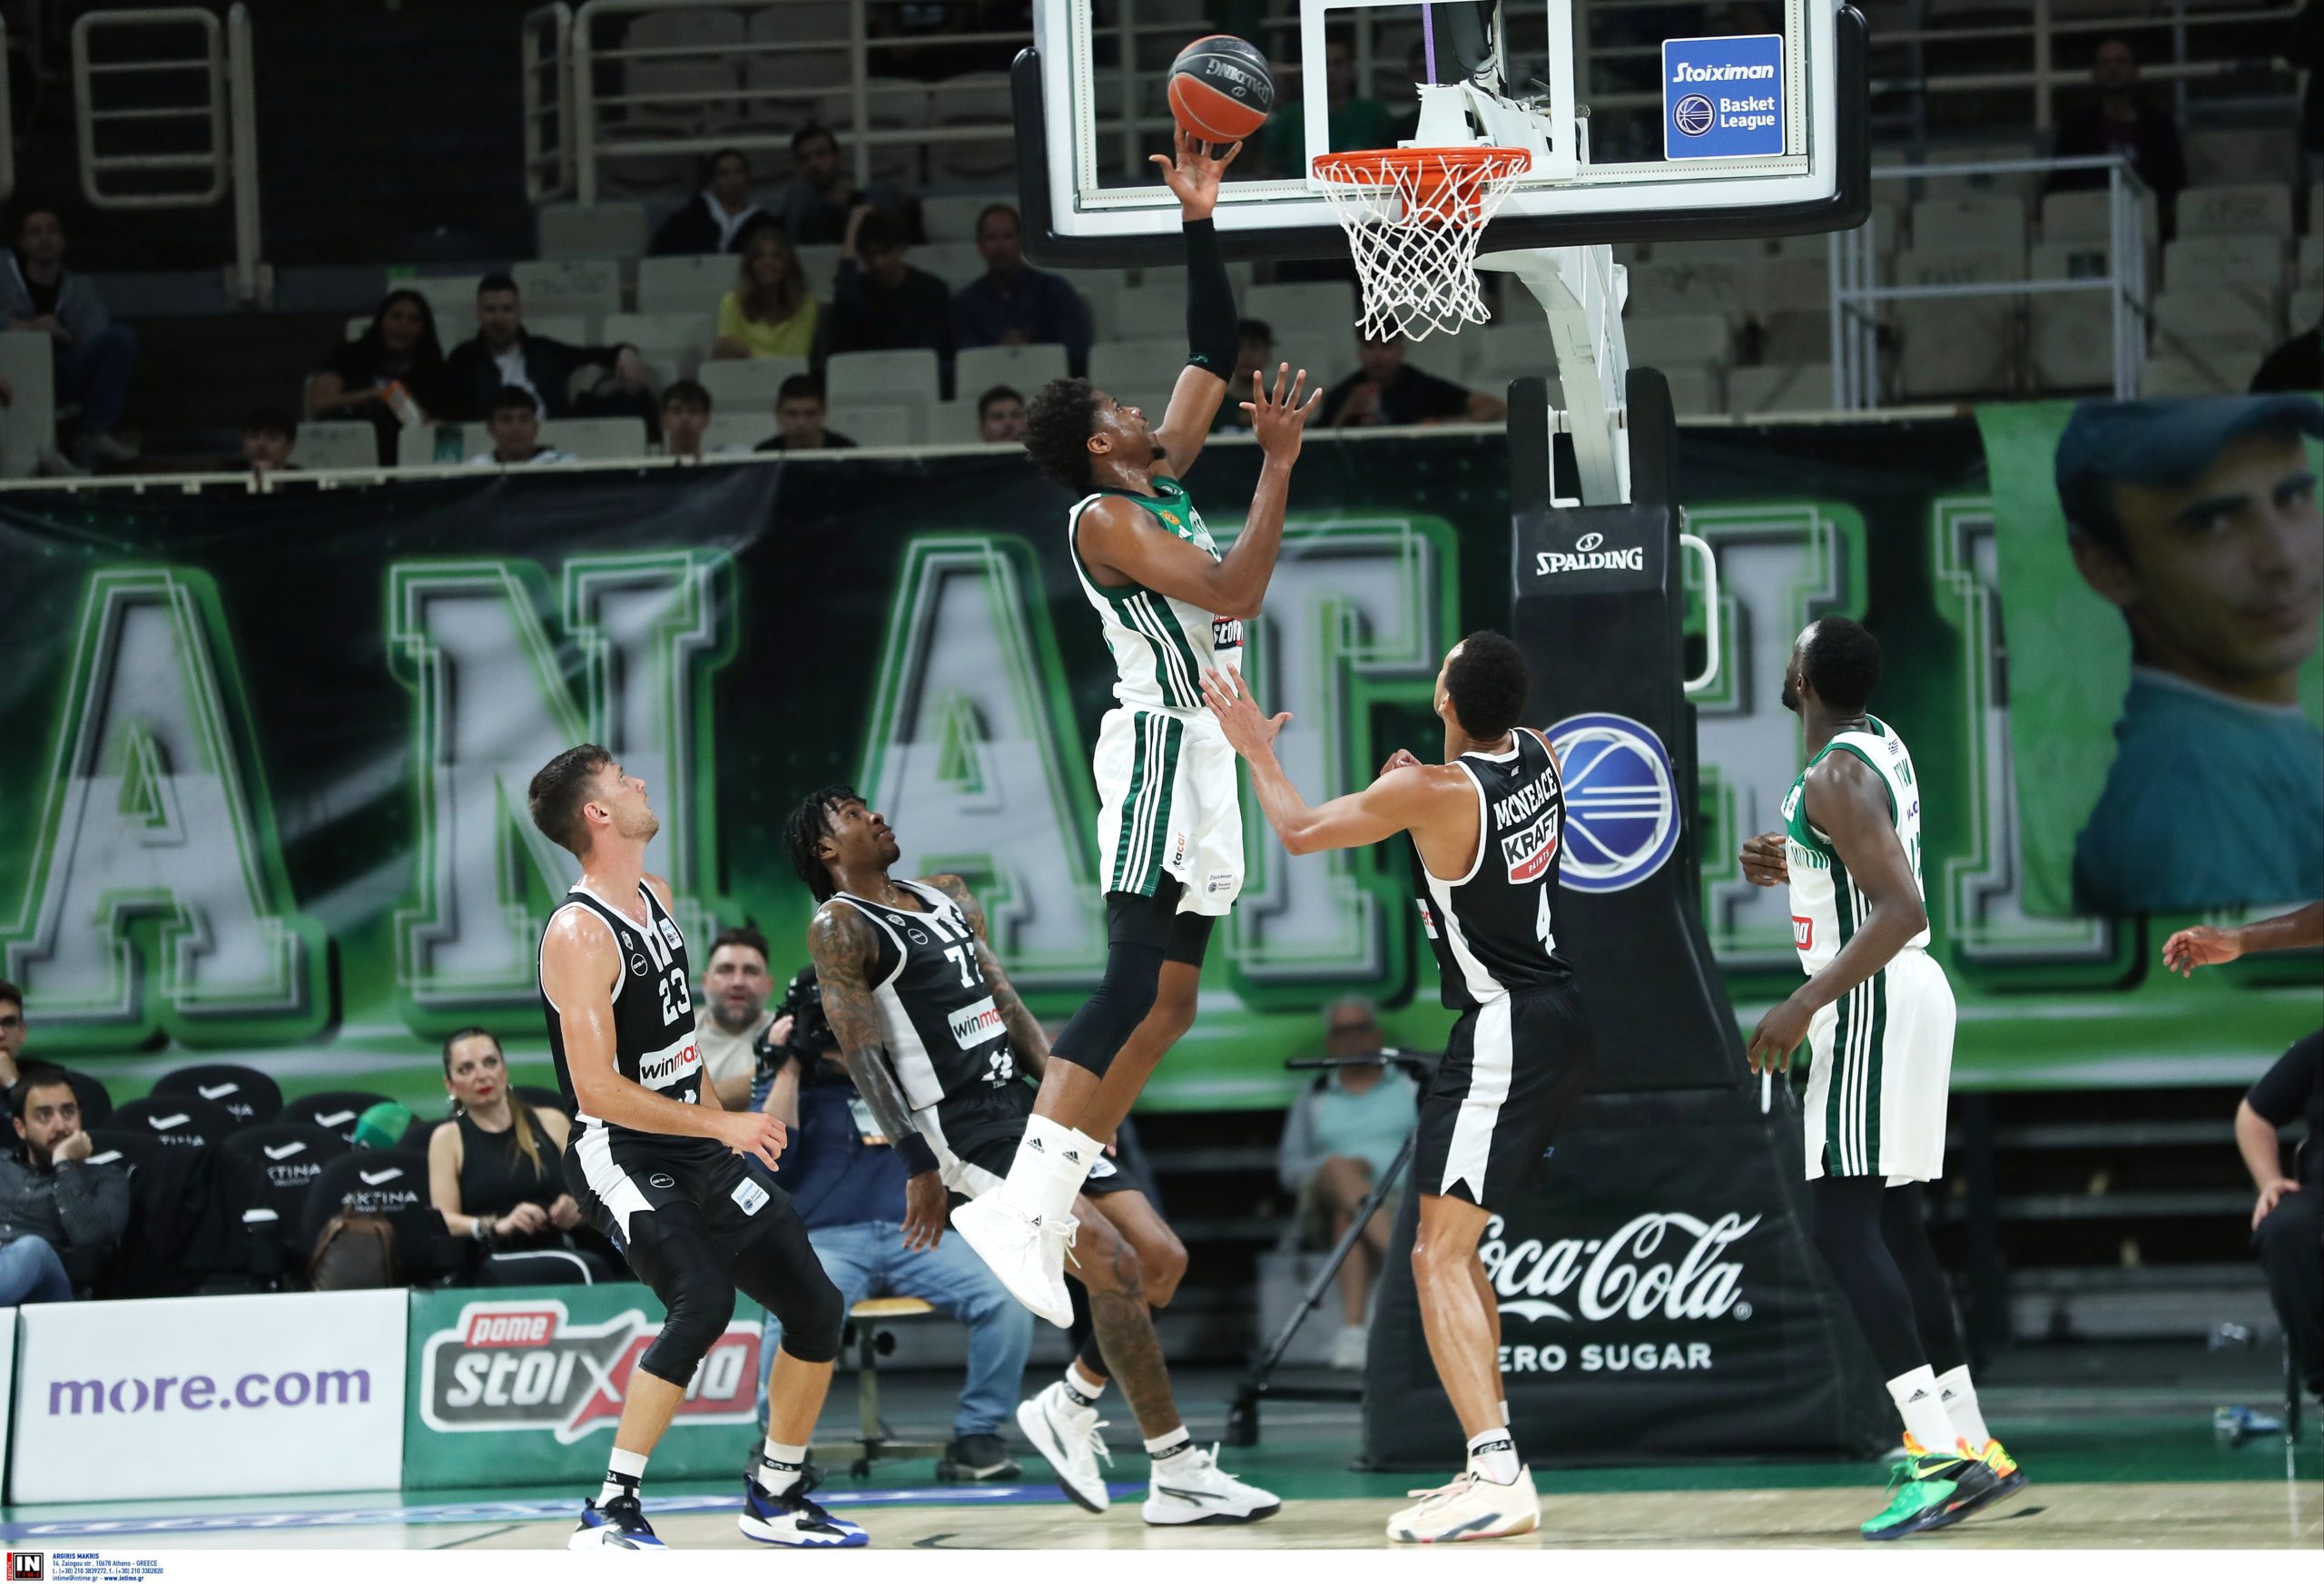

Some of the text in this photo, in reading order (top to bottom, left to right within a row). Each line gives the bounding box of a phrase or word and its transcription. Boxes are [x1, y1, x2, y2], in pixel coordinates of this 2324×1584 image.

[1672, 62, 1775, 83] Stoiximan
[1719, 95, 1776, 113] Basket
[1720, 114, 1776, 131] League
[1536, 546, 1643, 576] SPALDING
[1493, 766, 1558, 831] MCNEACE
[1503, 811, 1558, 865] KRAFT
[1528, 849, 1550, 874] PAINTS
[1535, 881, 1557, 957] 4
[658, 967, 691, 1027] 23
[1479, 1211, 1764, 1321] oca-Cola
[471, 1315, 549, 1346] pame
[1498, 1343, 1712, 1372] ERO SUGAR
[48, 1368, 371, 1416] more.com
